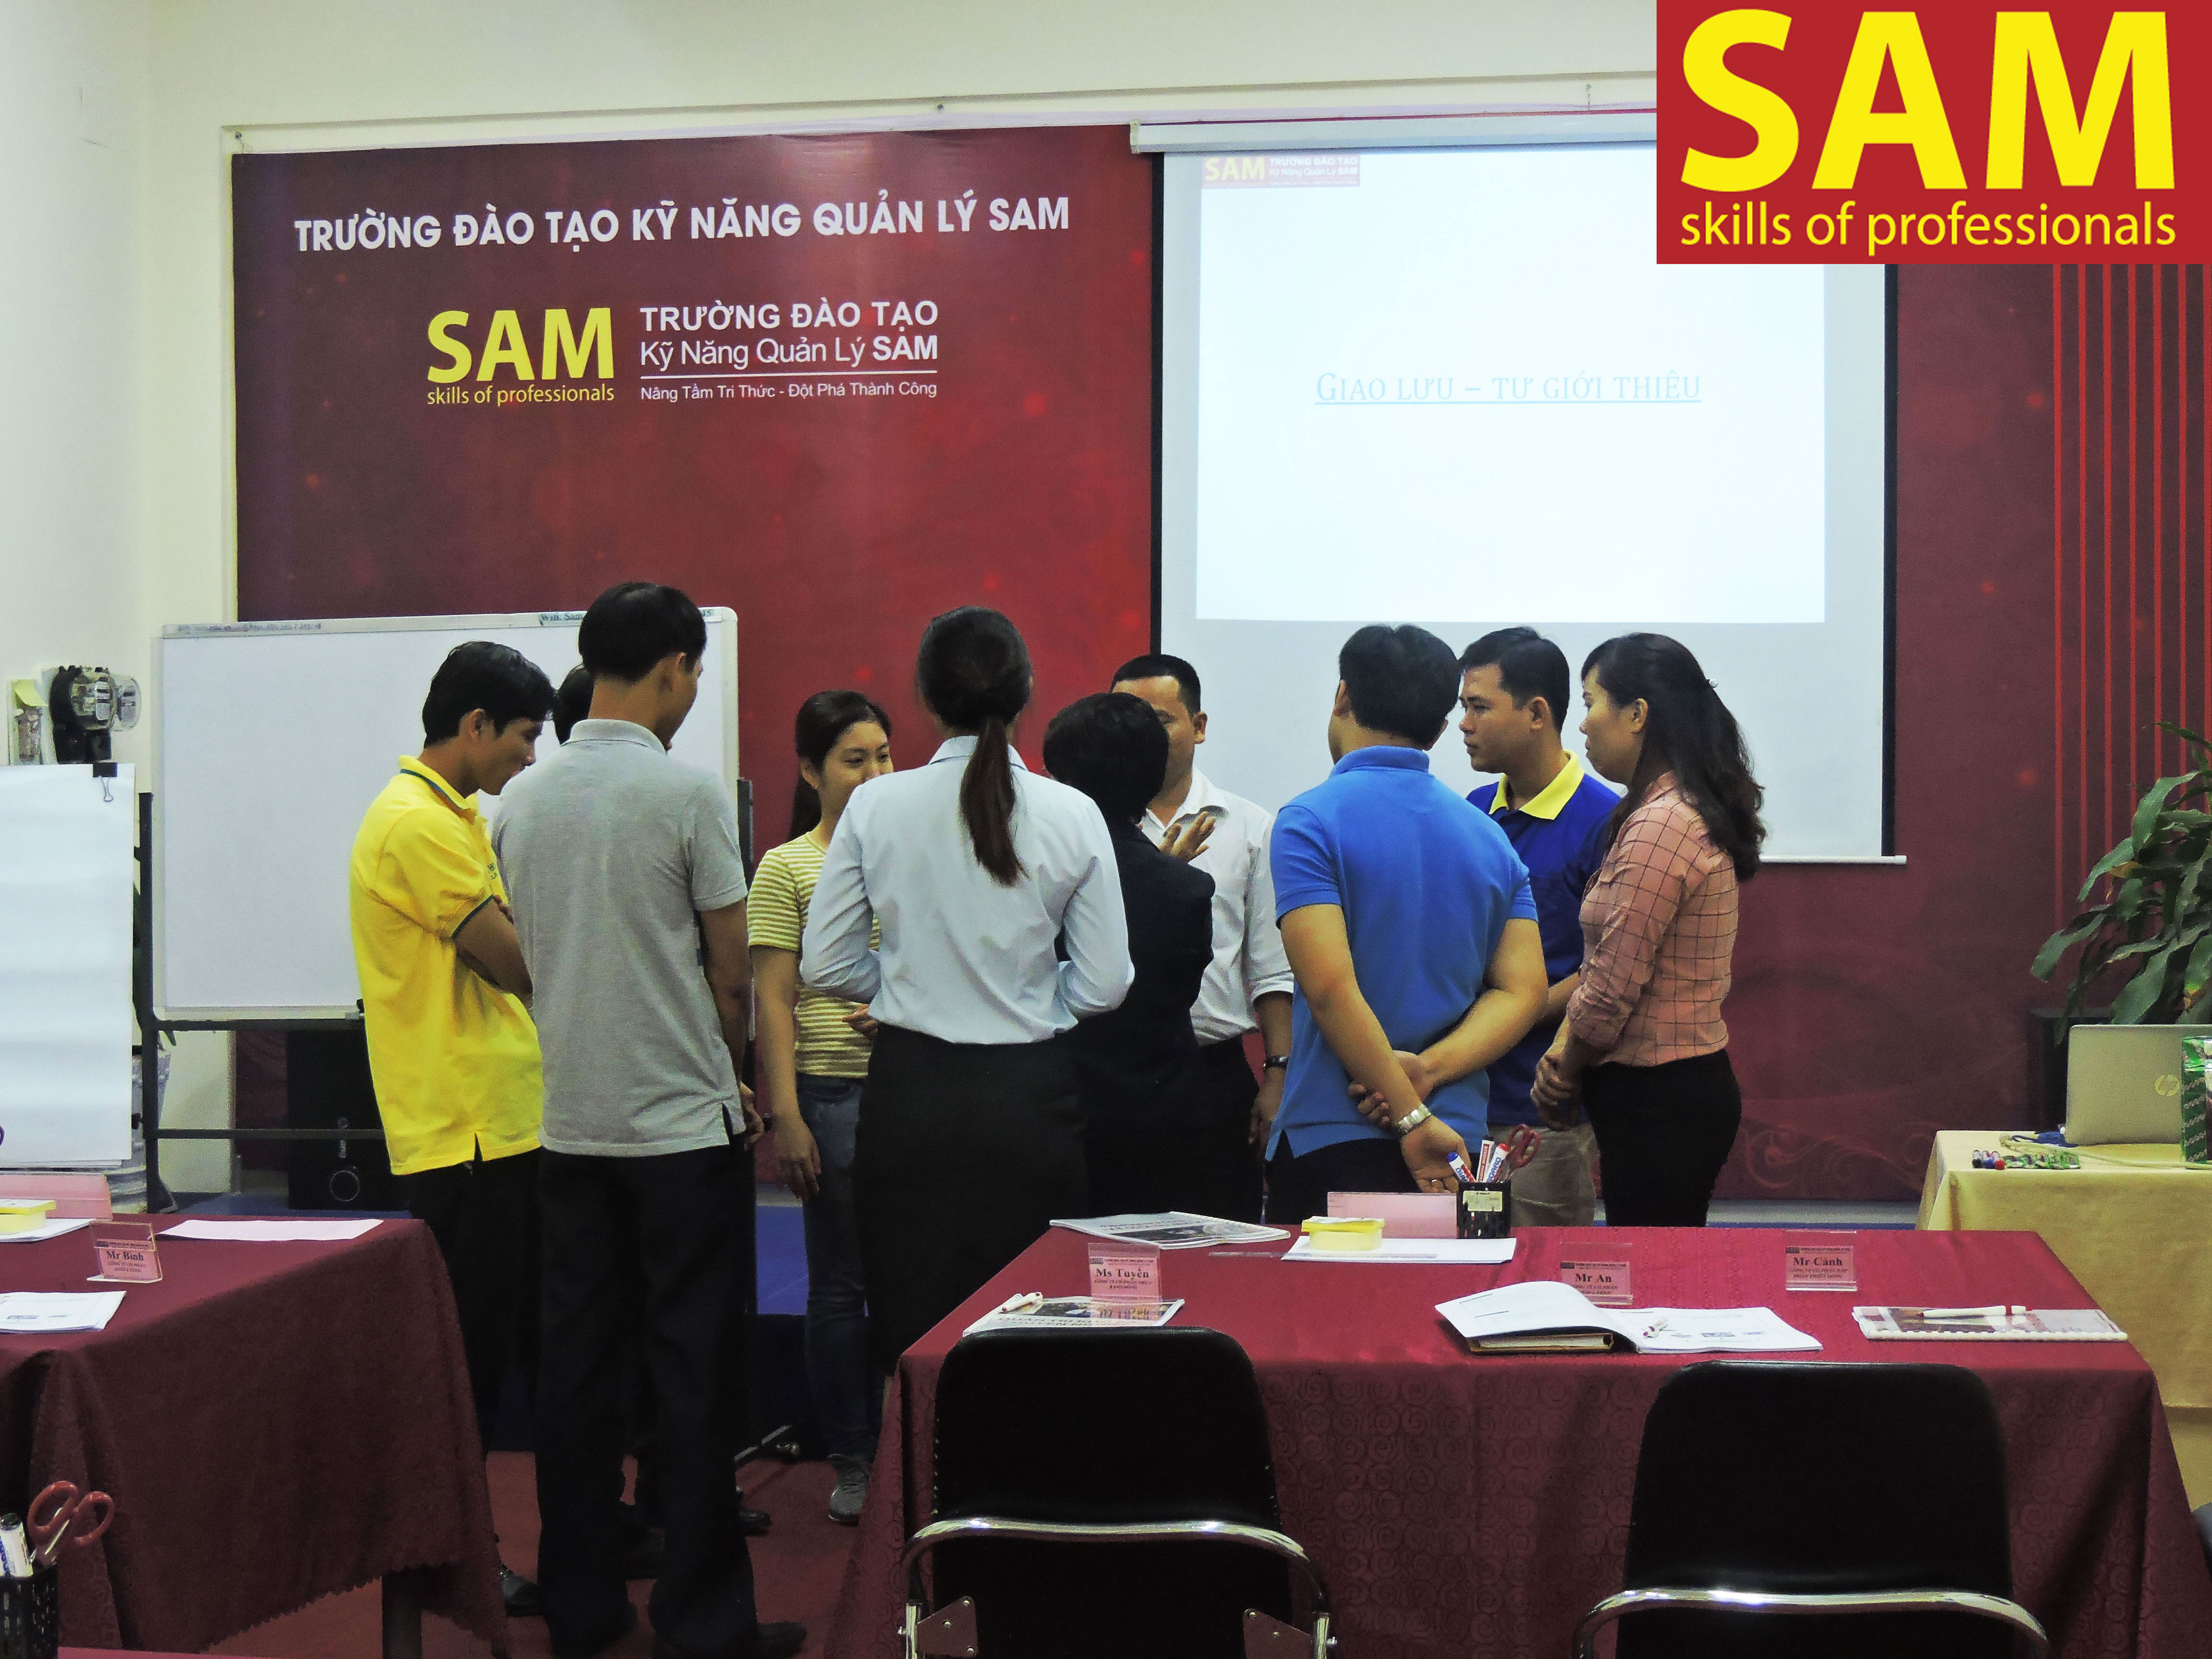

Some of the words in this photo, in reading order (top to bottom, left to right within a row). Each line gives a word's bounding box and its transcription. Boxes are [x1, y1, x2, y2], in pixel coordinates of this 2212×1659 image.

[1205, 156, 1264, 181] SAM
[295, 208, 441, 251] TRƯỜNG
[453, 204, 534, 246] ĐÀO
[546, 210, 618, 252] TẠO
[633, 200, 678, 240] KỸ
[691, 198, 801, 239] NĂNG
[814, 190, 922, 235] QUẢN
[938, 190, 977, 232] LÝ
[990, 197, 1068, 231] SAM
[640, 300, 780, 331] TRƯỜNG
[791, 297, 860, 327] ĐÀO
[872, 301, 938, 332] TẠO
[428, 308, 613, 383] SAM
[642, 342, 673, 371] Kỹ
[682, 341, 748, 370] Năng
[757, 337, 826, 363] Quản
[836, 337, 865, 367] Lý
[873, 336, 937, 360] SAM
[428, 387, 469, 404] skills
[475, 385, 493, 403] of
[498, 384, 614, 407] professionals
[641, 387, 677, 402] Nâng
[682, 384, 712, 398] Tầm
[718, 385, 733, 397] Trí
[739, 385, 775, 397] Thức
[789, 384, 813, 398] Đột
[818, 383, 845, 396] Phá
[850, 383, 894, 395] Thành
[899, 382, 936, 397] Công
[1398, 377, 1454, 400] LƯU
[1543, 370, 1602, 399] GIỚI
[106, 1250, 120, 1260] Mr
[1793, 1257, 1810, 1266] Mr
[1096, 1268, 1112, 1277] Ms
[1575, 1274, 1593, 1283] Mr
[1597, 1274, 1612, 1283] An
